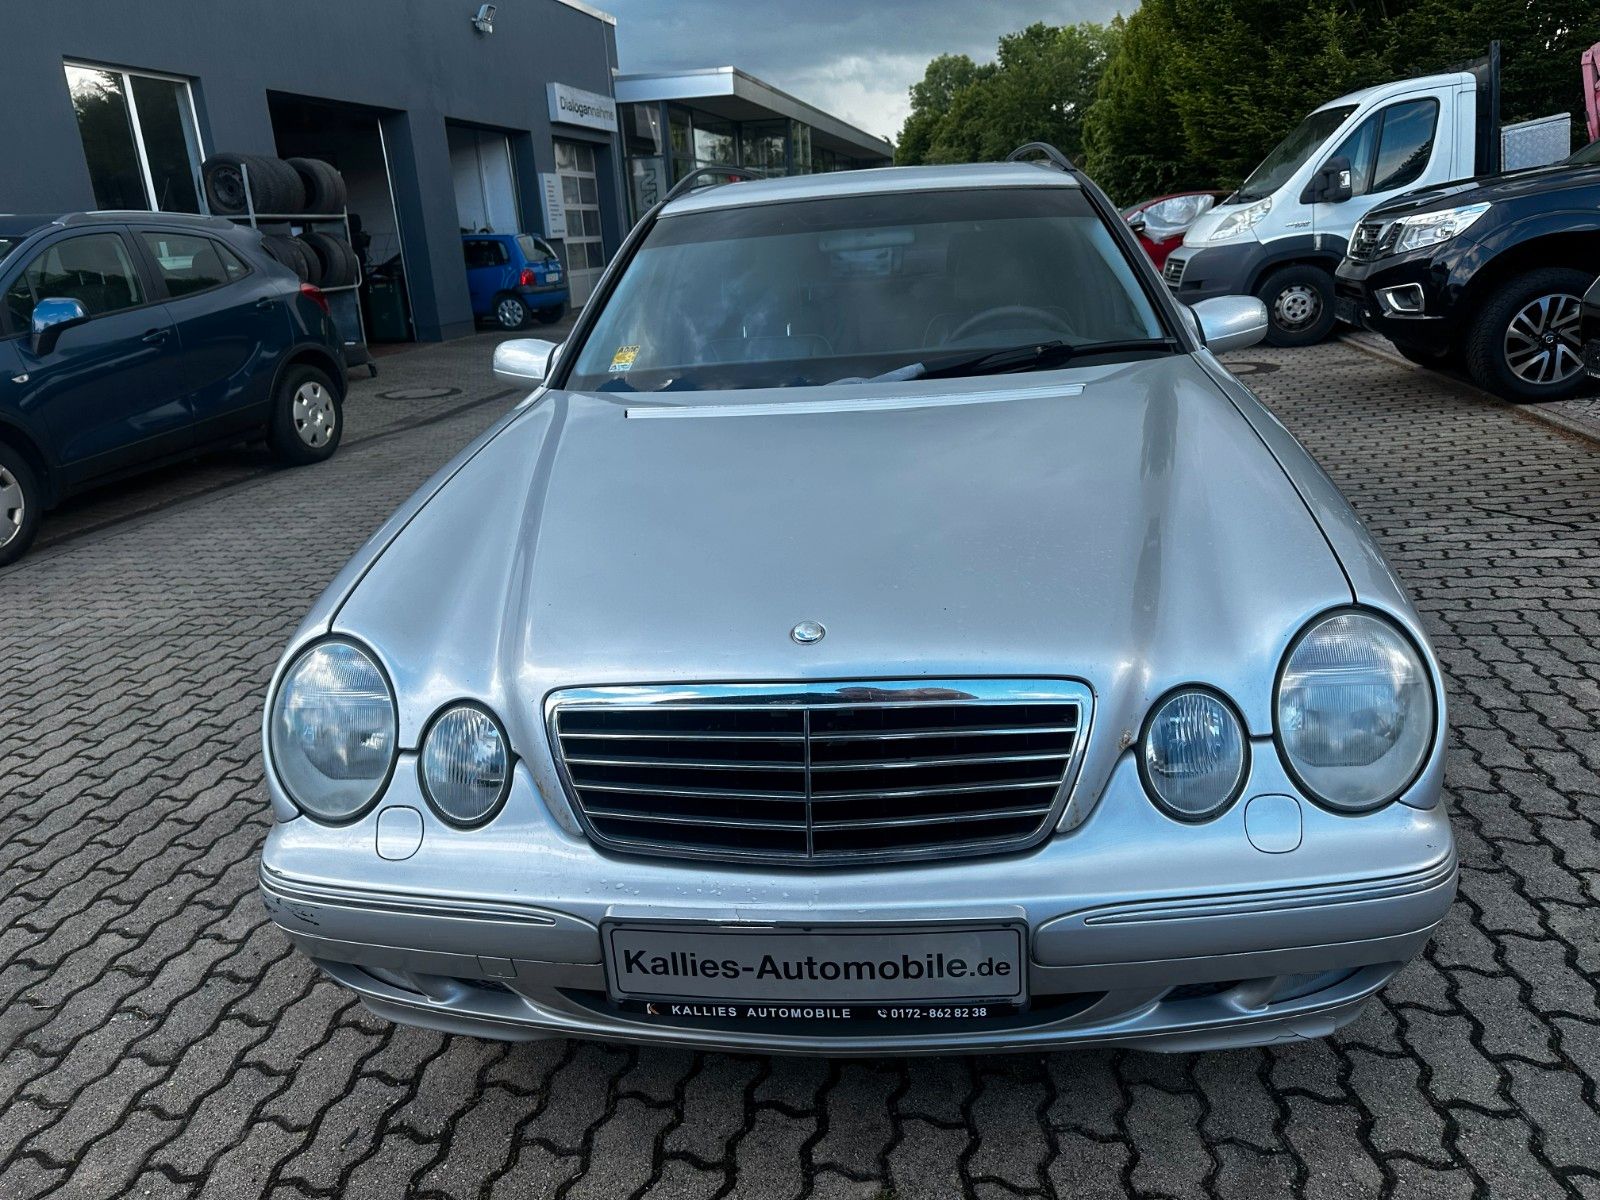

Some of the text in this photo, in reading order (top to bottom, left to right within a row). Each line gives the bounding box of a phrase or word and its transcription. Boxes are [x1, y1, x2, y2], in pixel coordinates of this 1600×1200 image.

[560, 96, 615, 120] Dialogannahme
[624, 950, 1011, 980] Kallies-Automobile.de
[671, 1005, 851, 1019] KALLIES AUTOMOBILE
